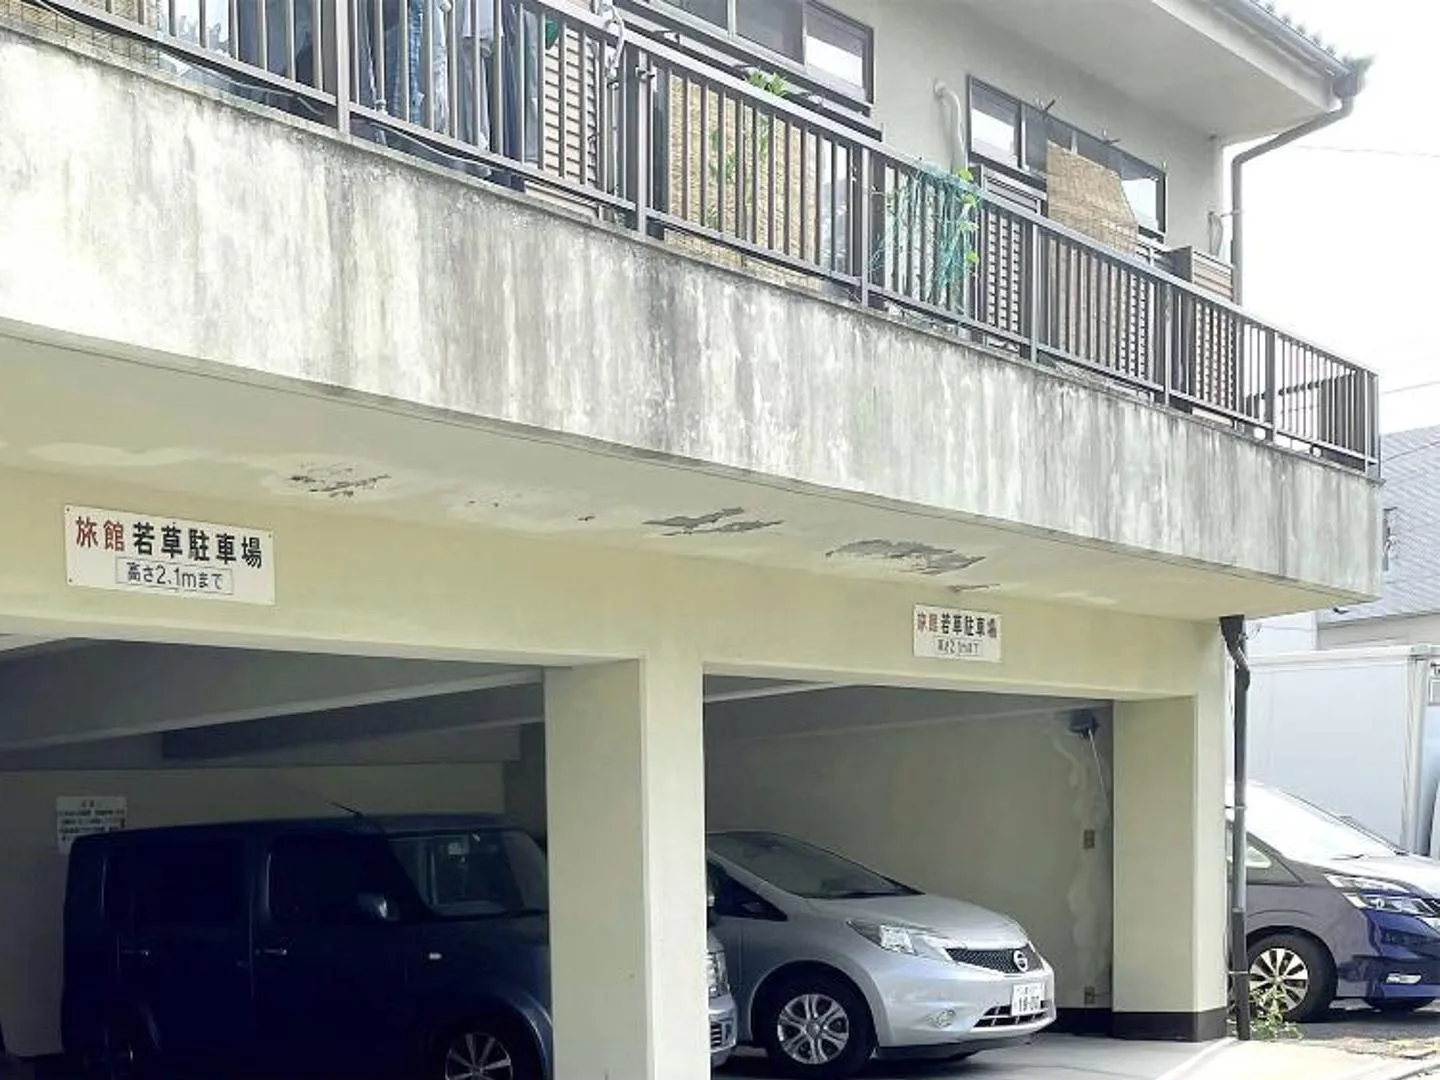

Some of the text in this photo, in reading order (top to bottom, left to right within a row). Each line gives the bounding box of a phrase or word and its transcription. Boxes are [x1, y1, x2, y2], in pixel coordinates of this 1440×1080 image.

[75, 515, 262, 569] 旅館若草駐車場
